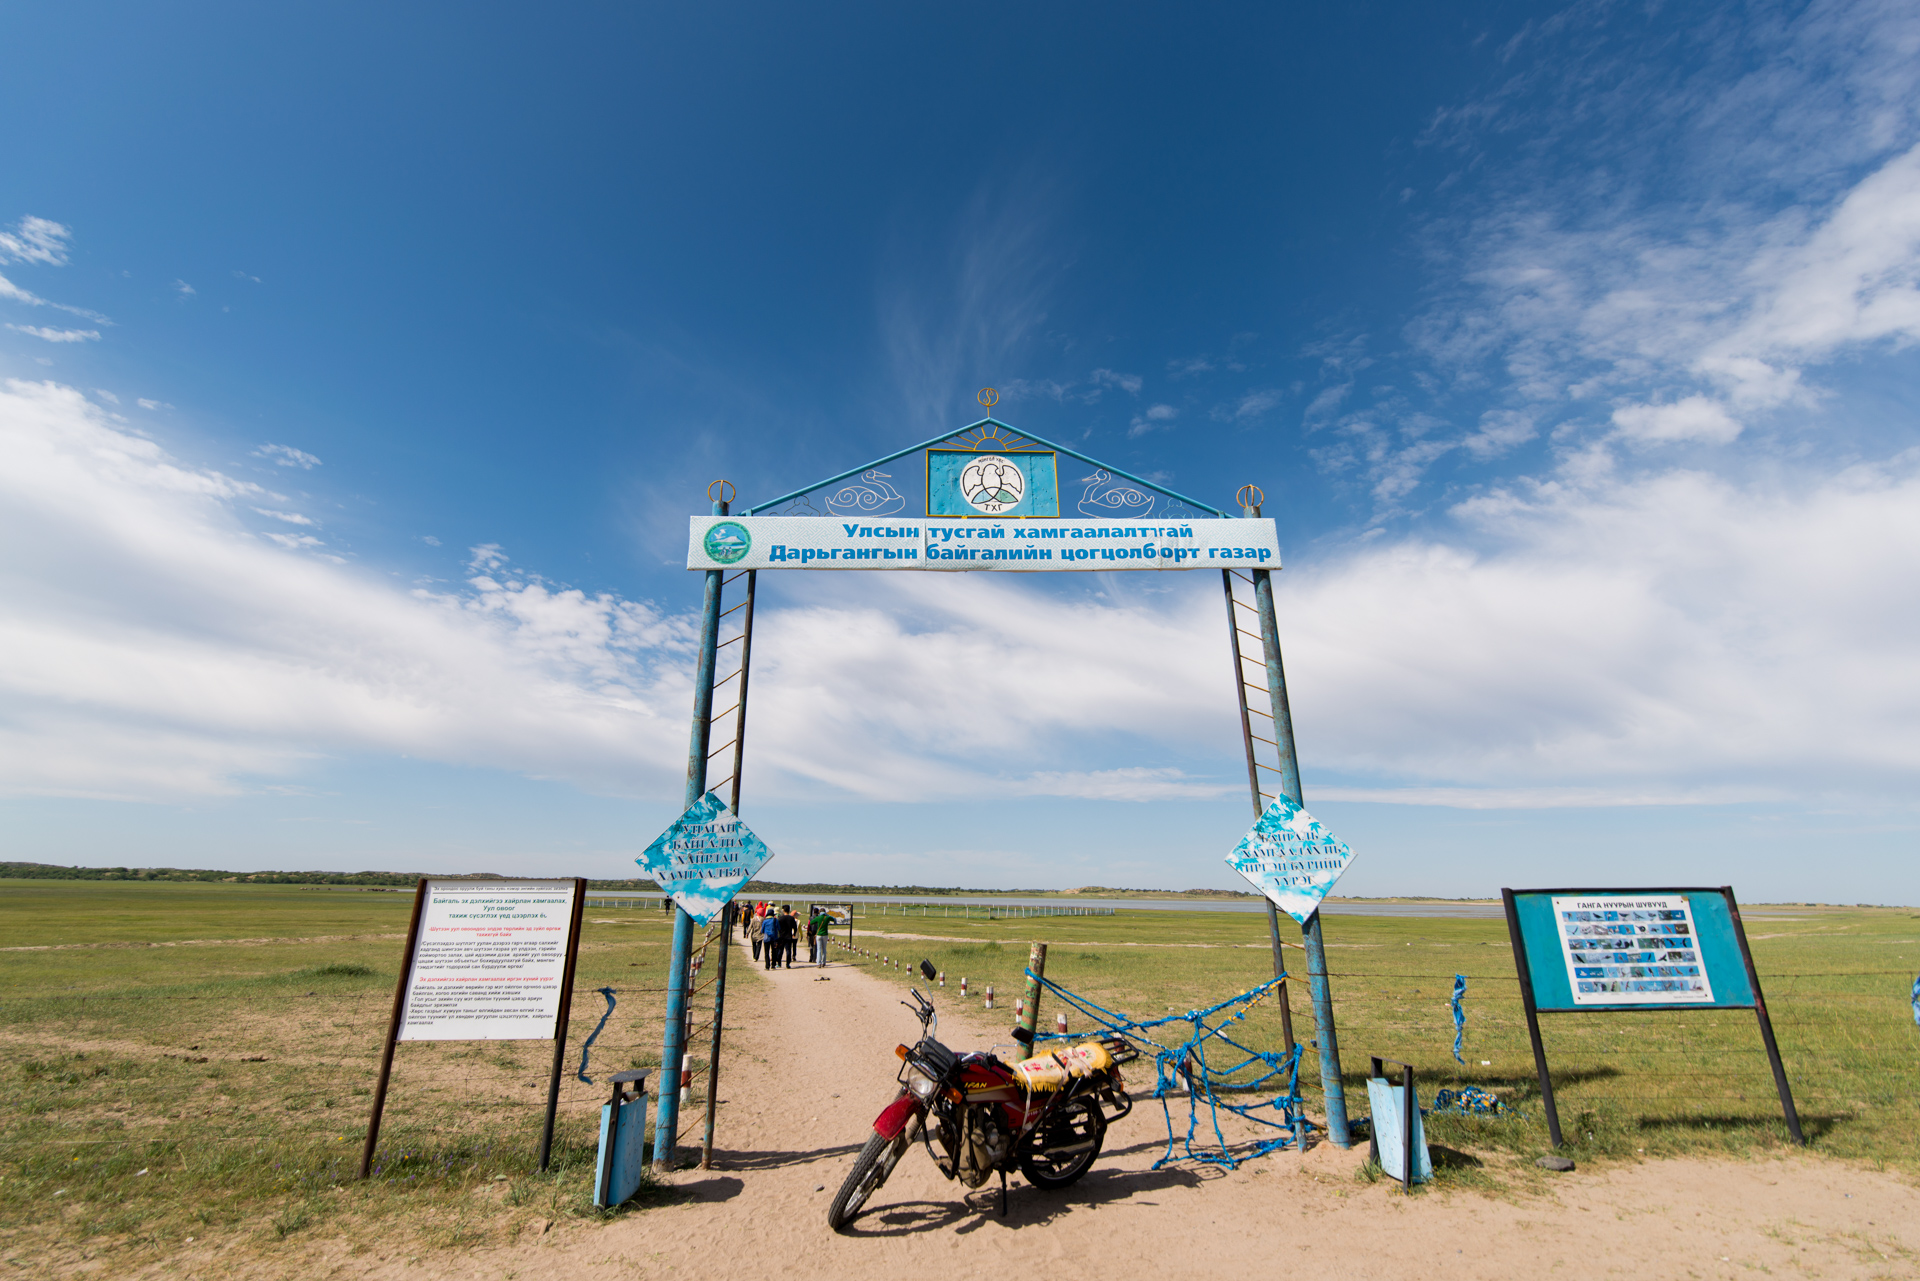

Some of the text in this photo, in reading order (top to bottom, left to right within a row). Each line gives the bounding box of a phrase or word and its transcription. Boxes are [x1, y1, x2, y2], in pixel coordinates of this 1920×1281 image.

[984, 503, 1003, 512] ТХГ
[843, 523, 1193, 543] Улсын тусгай хамгаалалттай
[769, 544, 918, 564] Дарьгангын
[926, 543, 1053, 561] байгалийн
[1208, 547, 1272, 563] газар
[682, 823, 736, 834] УНАГАН
[1261, 830, 1319, 843] БАЙГАЛЬ
[677, 851, 739, 865] ХАЙРЛАН
[1242, 845, 1342, 859] ХАМГААЛАХ НЬ
[1244, 858, 1342, 873] ИРГЭН БҮРИЙН
[1274, 875, 1314, 886] ҮҮРЭГ
[1636, 901, 1668, 909] ШУВУУД
[964, 1081, 988, 1089] IFAN
